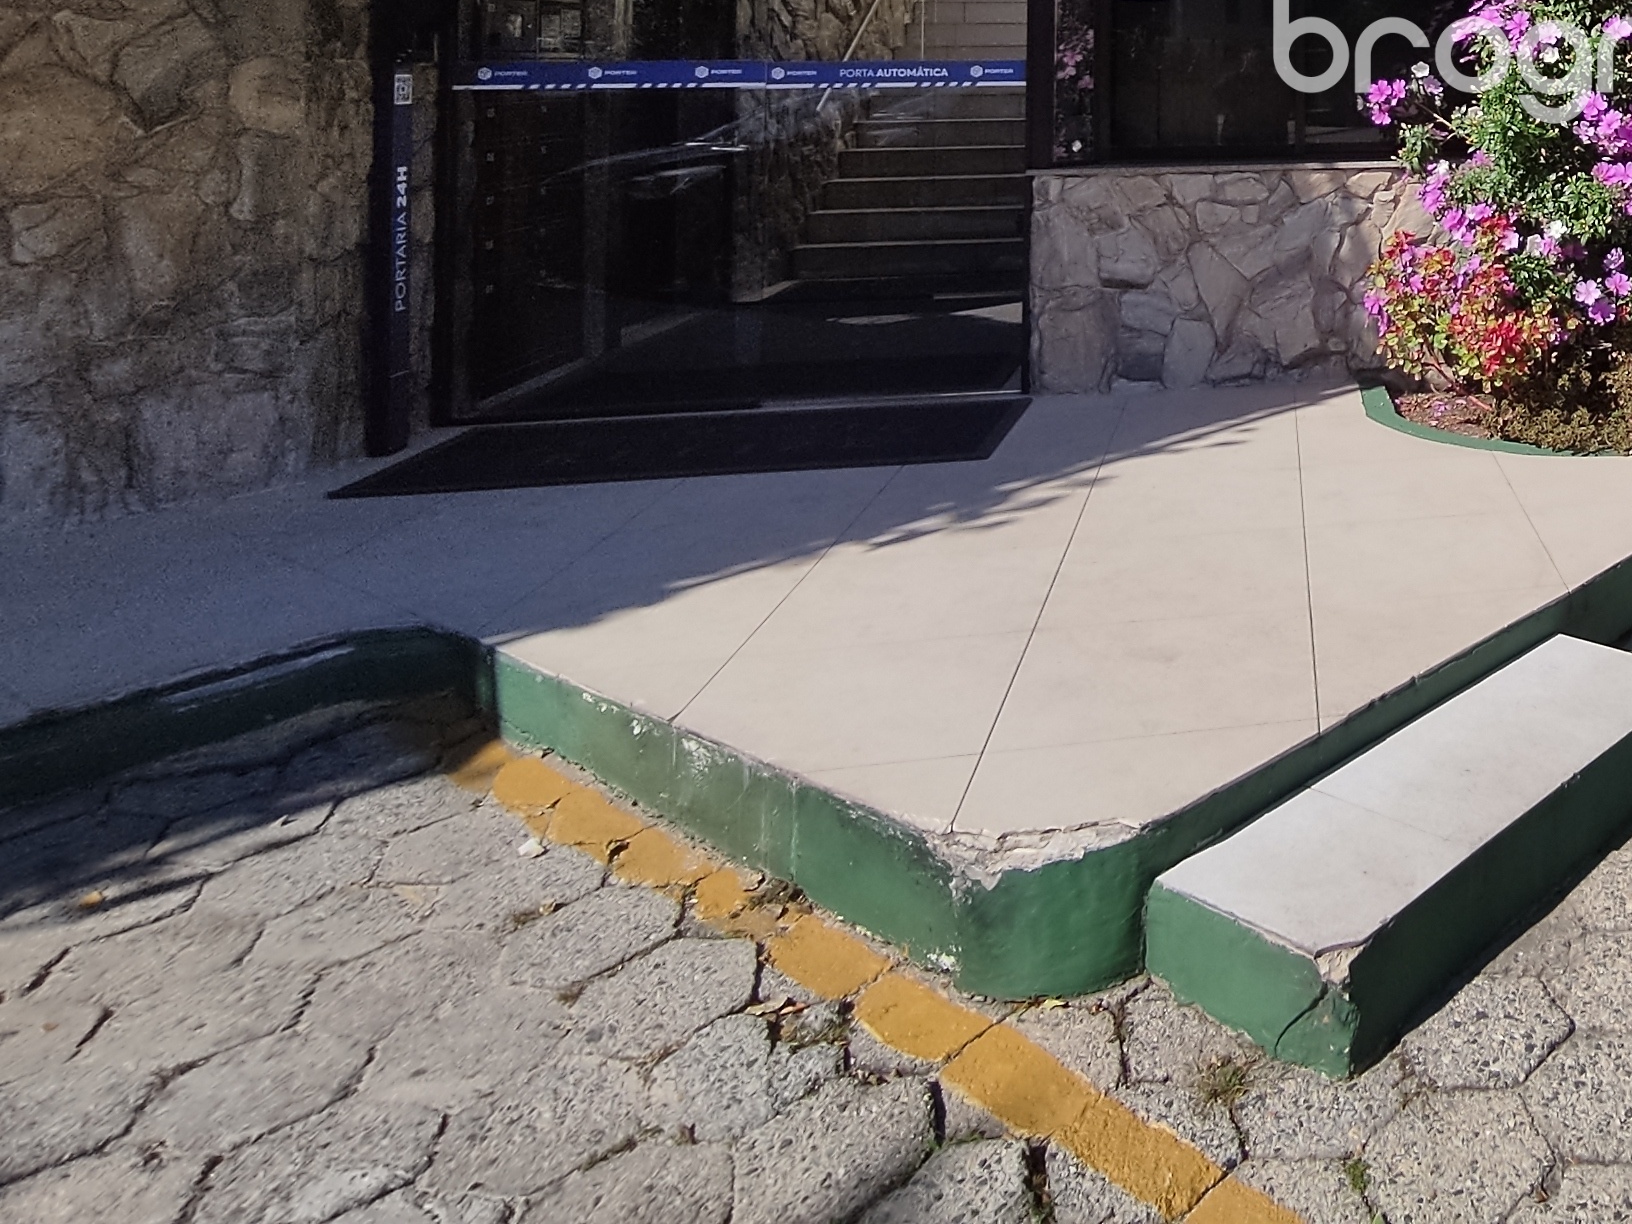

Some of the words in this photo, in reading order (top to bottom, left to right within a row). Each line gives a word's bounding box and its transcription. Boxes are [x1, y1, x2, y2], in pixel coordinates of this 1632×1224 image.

[839, 68, 875, 78] PORTA
[876, 66, 949, 77] AUTOMÁTICA
[396, 166, 408, 207] 24H
[395, 214, 407, 312] PORTARIA
